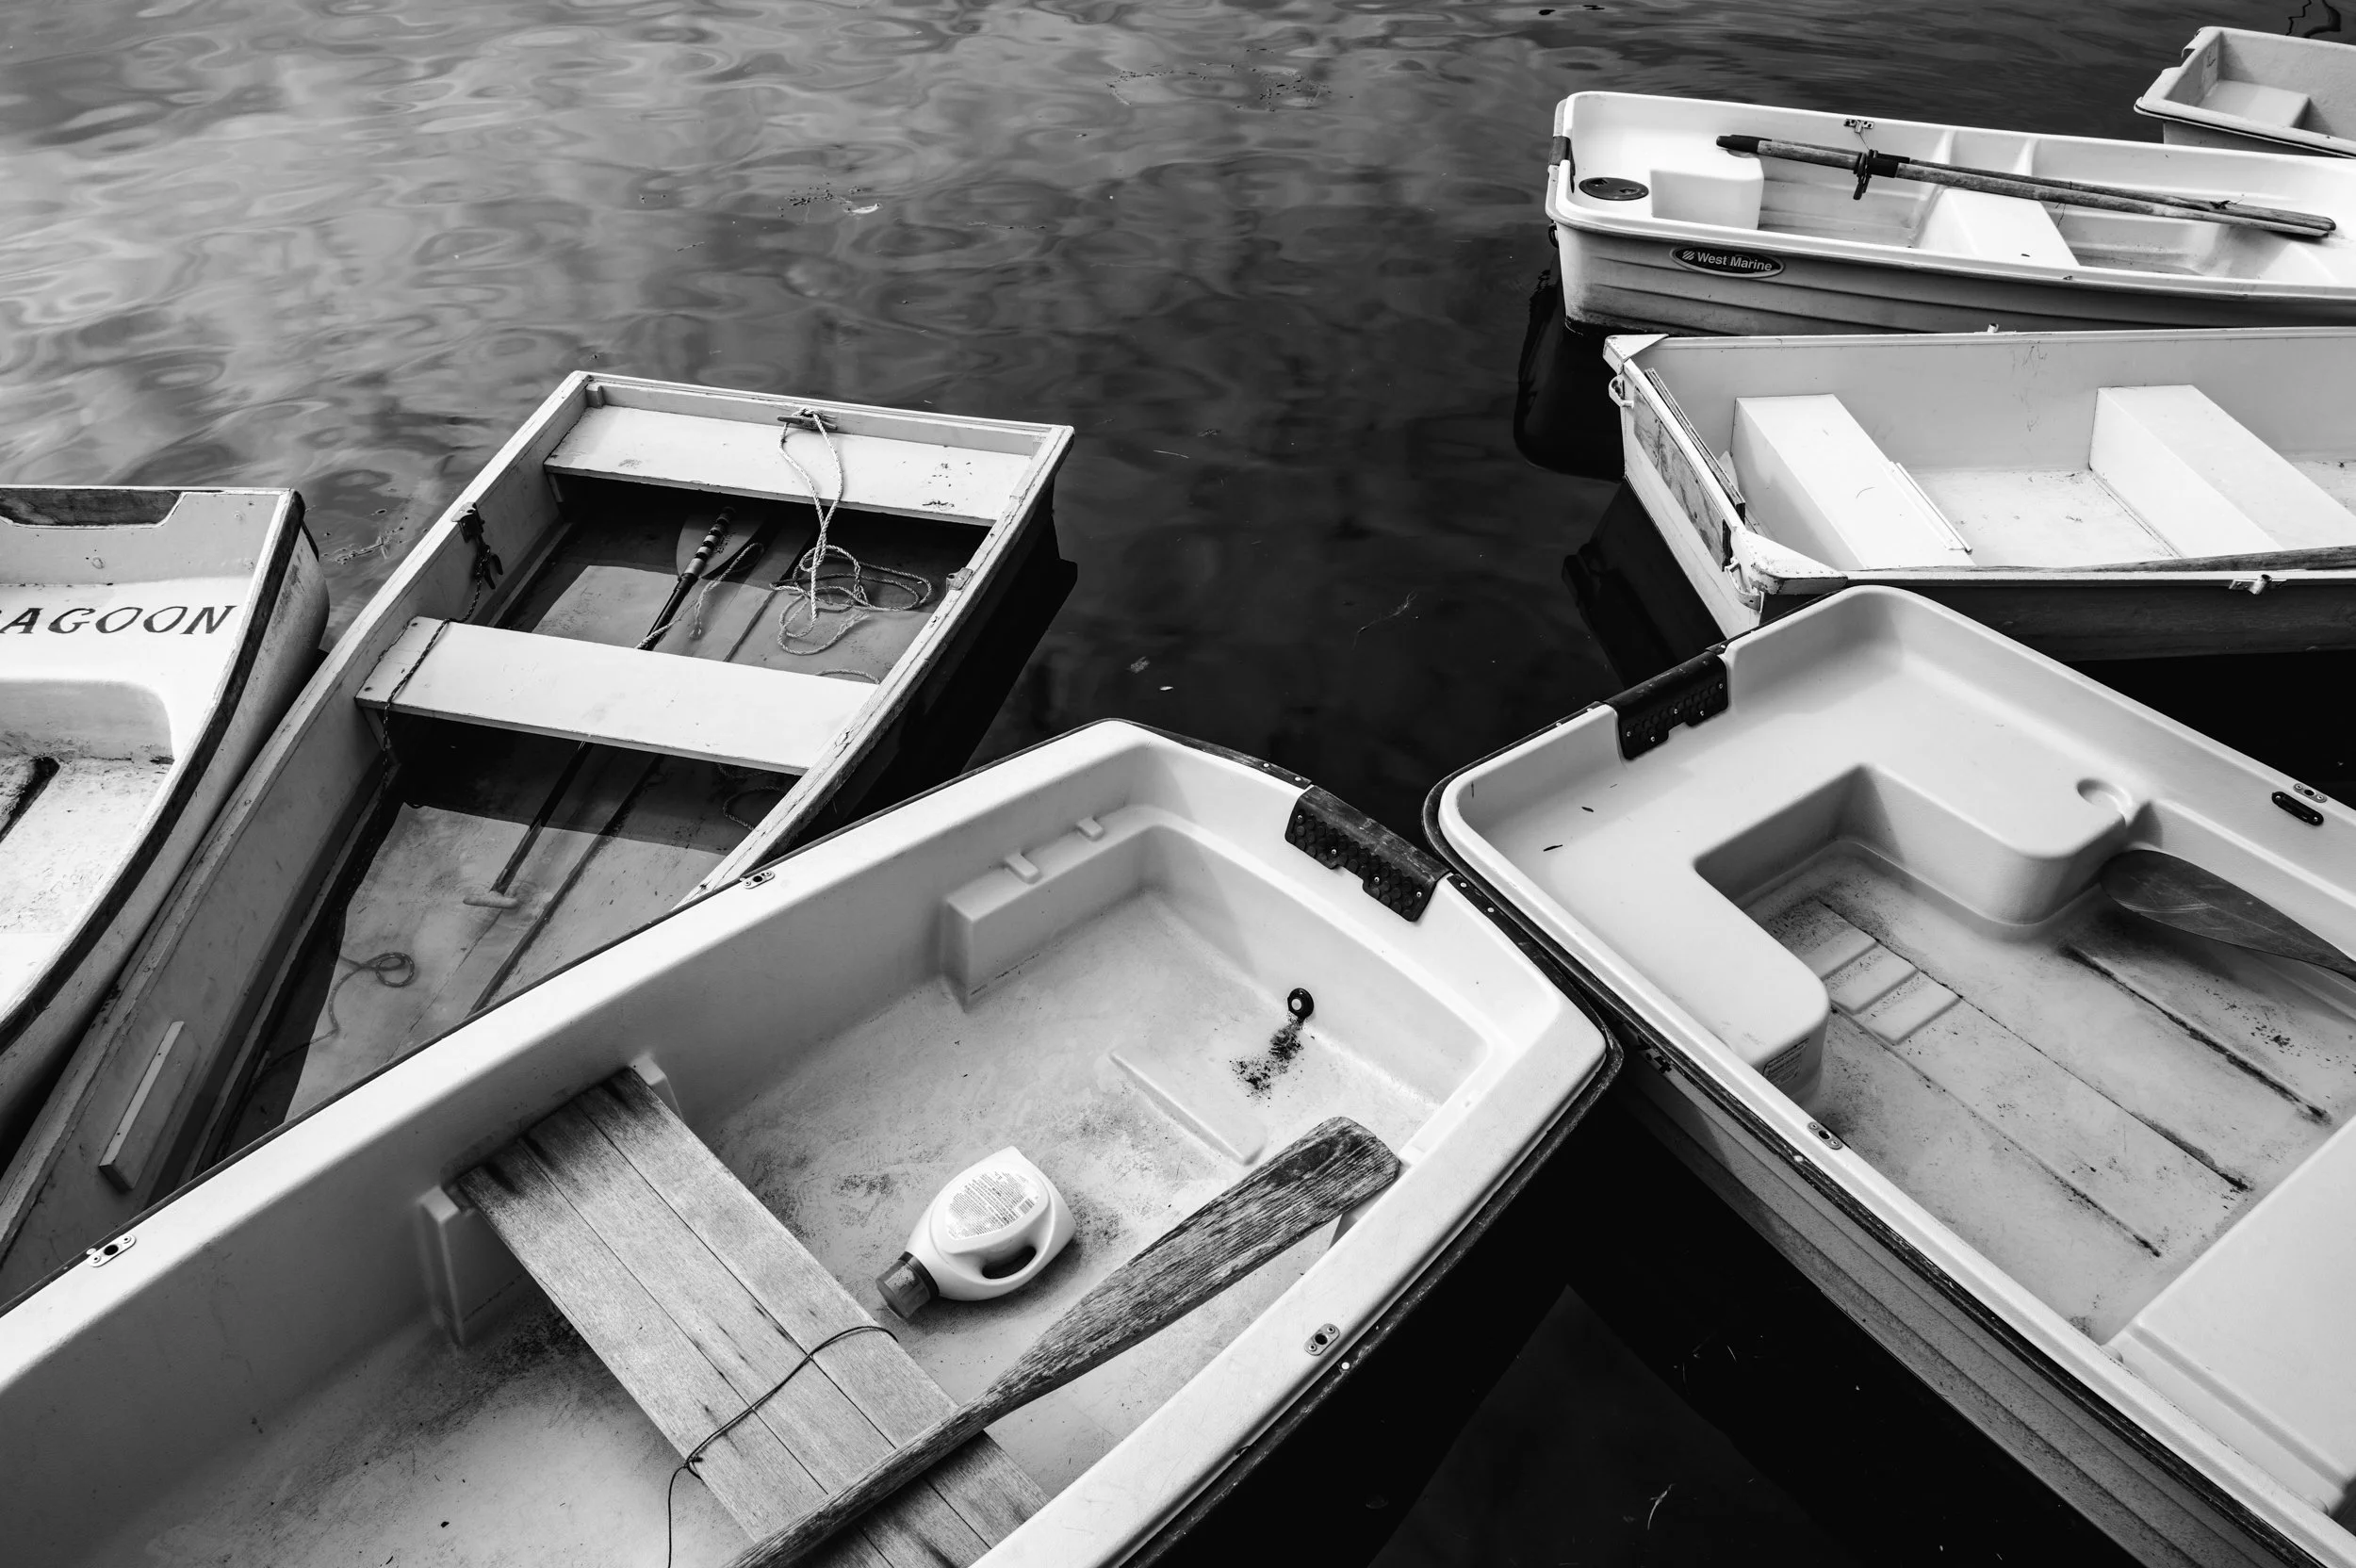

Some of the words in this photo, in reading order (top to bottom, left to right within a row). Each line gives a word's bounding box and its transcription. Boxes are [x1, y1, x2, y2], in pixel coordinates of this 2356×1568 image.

[1697, 252, 1727, 265] West
[1730, 256, 1773, 271] Marine
[0, 605, 237, 635] AGOON
